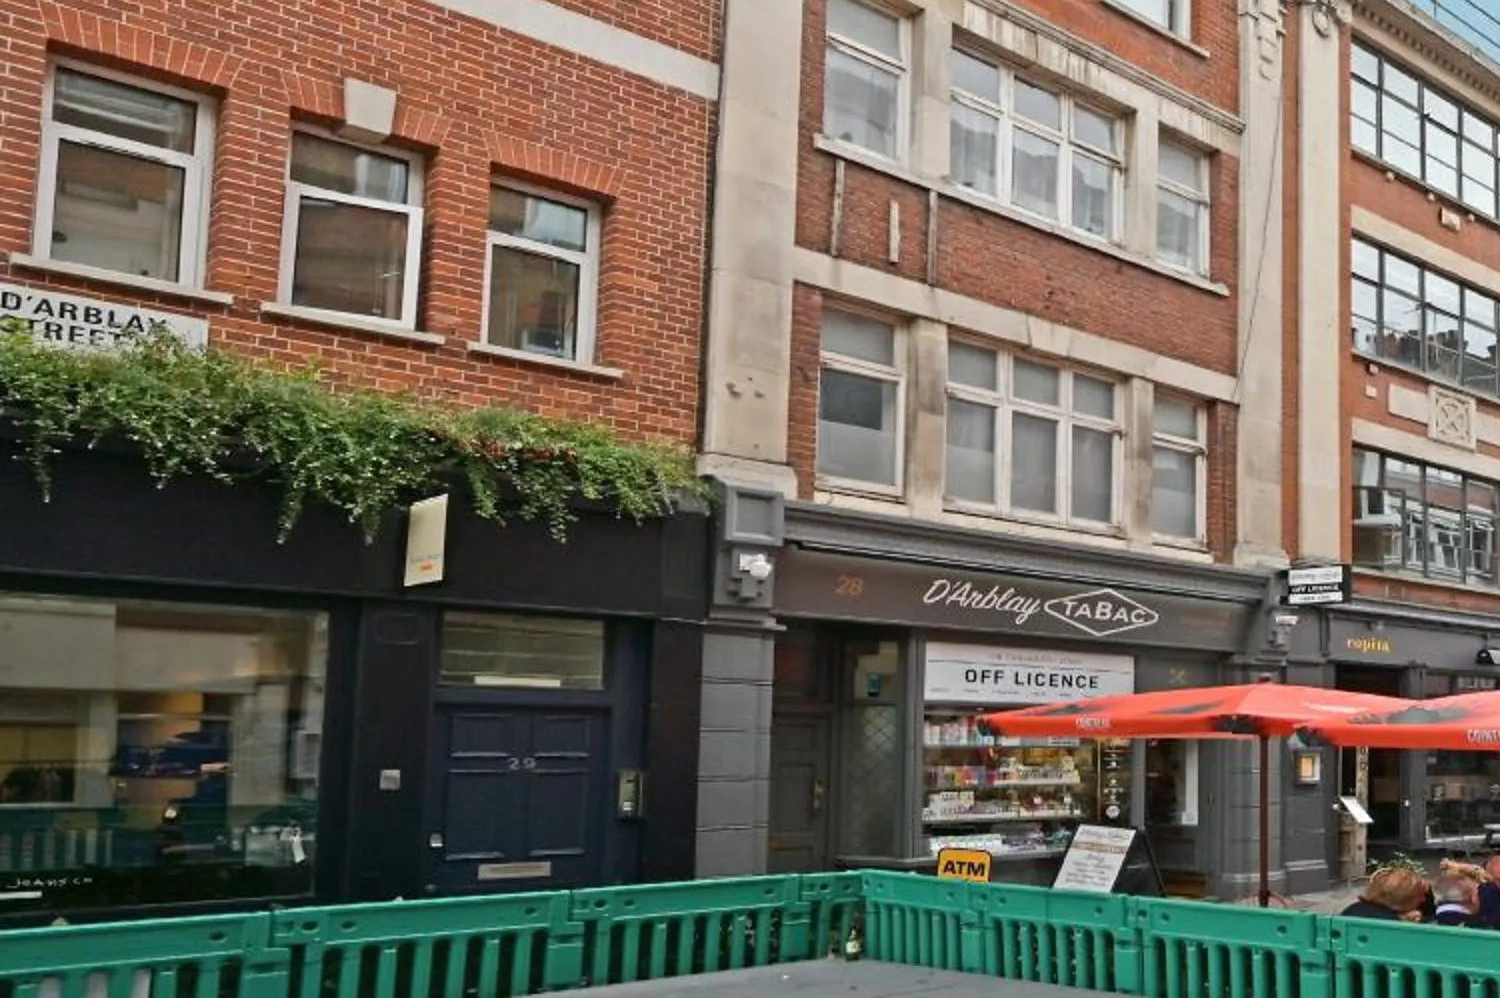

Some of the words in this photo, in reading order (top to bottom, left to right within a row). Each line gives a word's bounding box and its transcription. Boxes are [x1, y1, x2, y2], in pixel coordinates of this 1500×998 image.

[835, 575, 863, 596] 28
[923, 579, 1041, 625] D'Arblay
[965, 669, 1005, 685] OFF
[1014, 671, 1100, 689] LICENCE
[509, 757, 535, 771] 29
[943, 860, 986, 877] ATM
